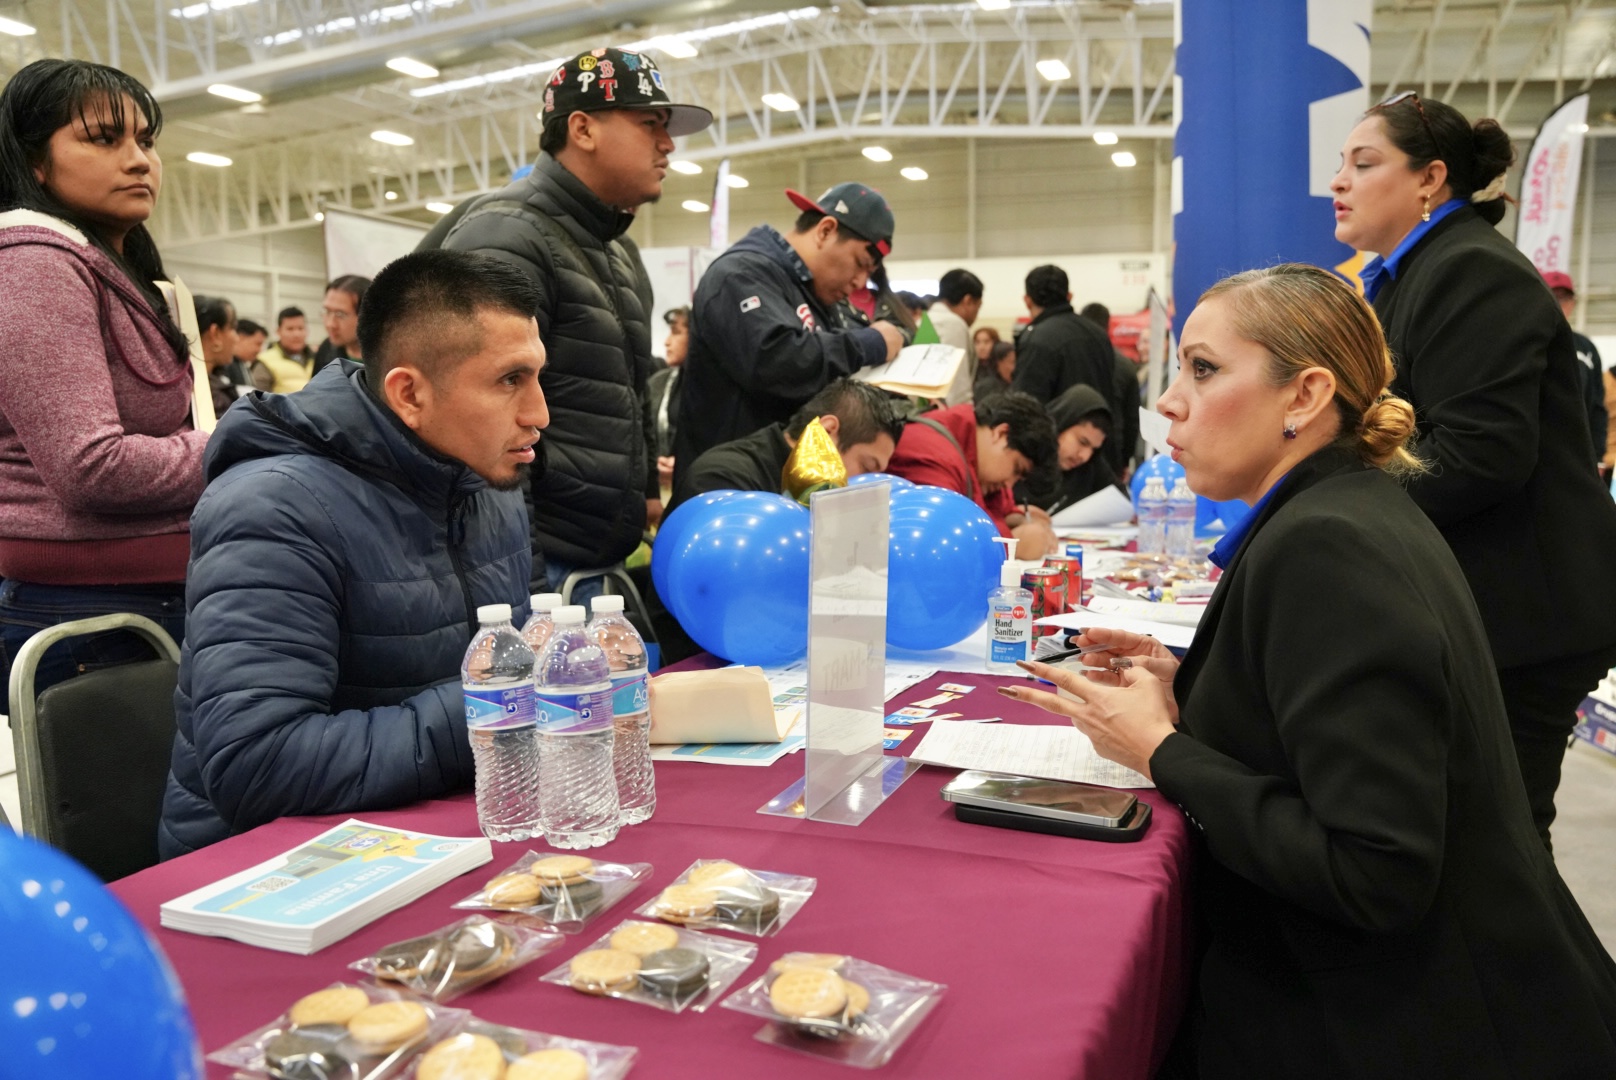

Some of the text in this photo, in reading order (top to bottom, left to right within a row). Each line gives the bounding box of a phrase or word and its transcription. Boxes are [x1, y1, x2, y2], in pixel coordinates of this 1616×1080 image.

[597, 60, 615, 78] B
[577, 71, 596, 93] P
[598, 79, 618, 101] T
[637, 72, 653, 96] LA
[995, 619, 1013, 628] Hand
[995, 628, 1023, 637] Sanitizer
